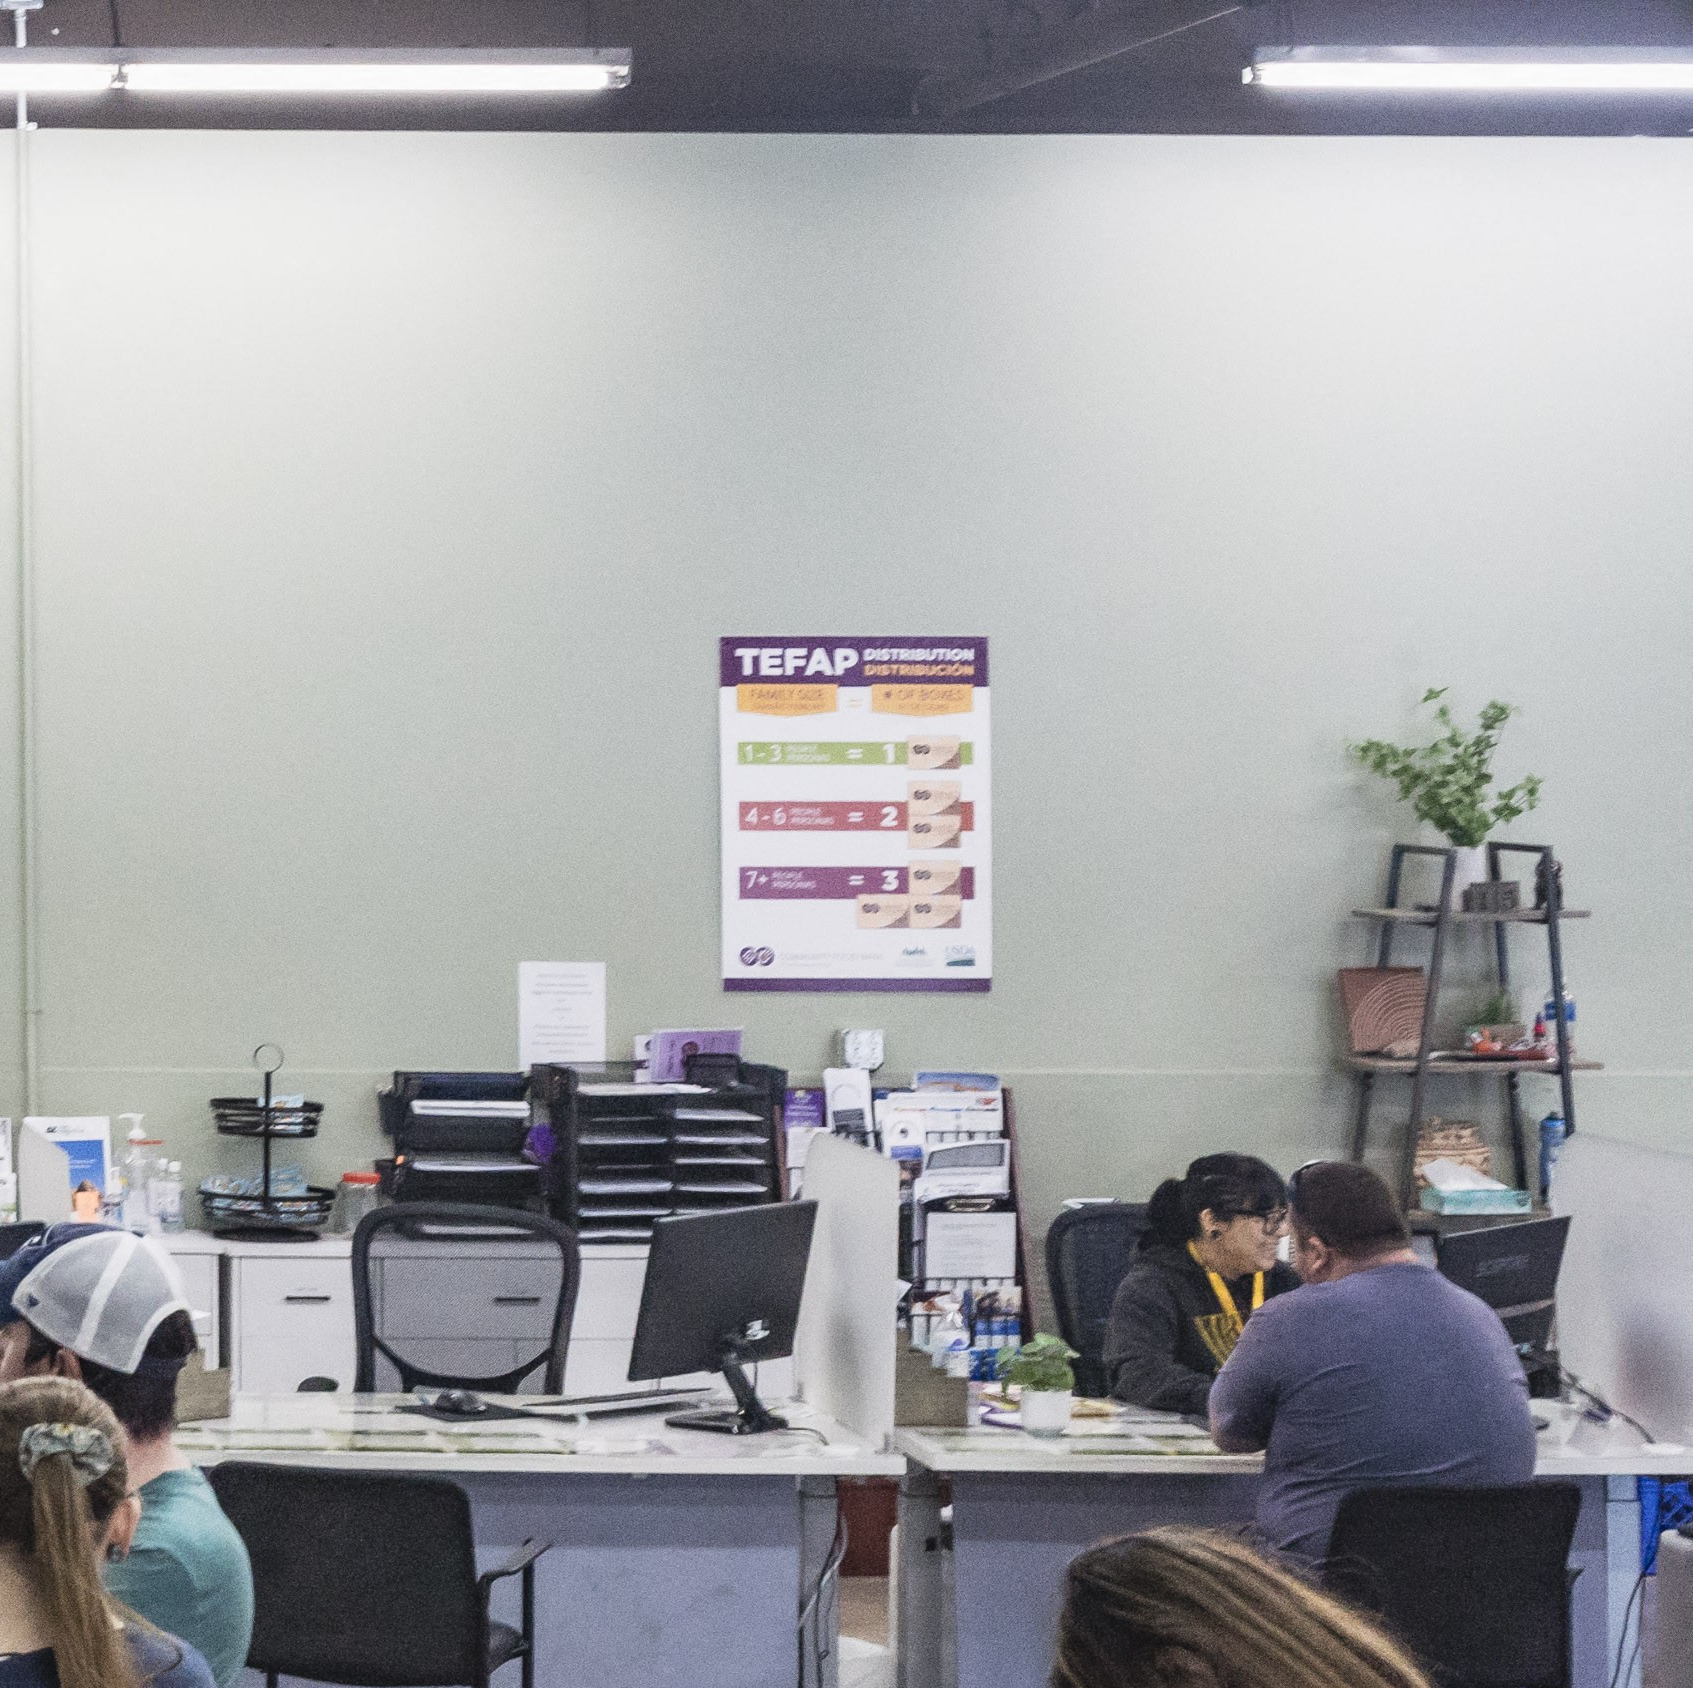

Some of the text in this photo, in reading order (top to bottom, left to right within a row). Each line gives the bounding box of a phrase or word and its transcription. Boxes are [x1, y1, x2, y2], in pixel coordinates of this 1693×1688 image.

[734, 647, 975, 677] TEFAP DISTRIBUTION
[863, 661, 975, 677] DISTRIBUCIÓN
[883, 743, 896, 764] 1
[880, 806, 899, 827] 2
[881, 870, 900, 891] 3
